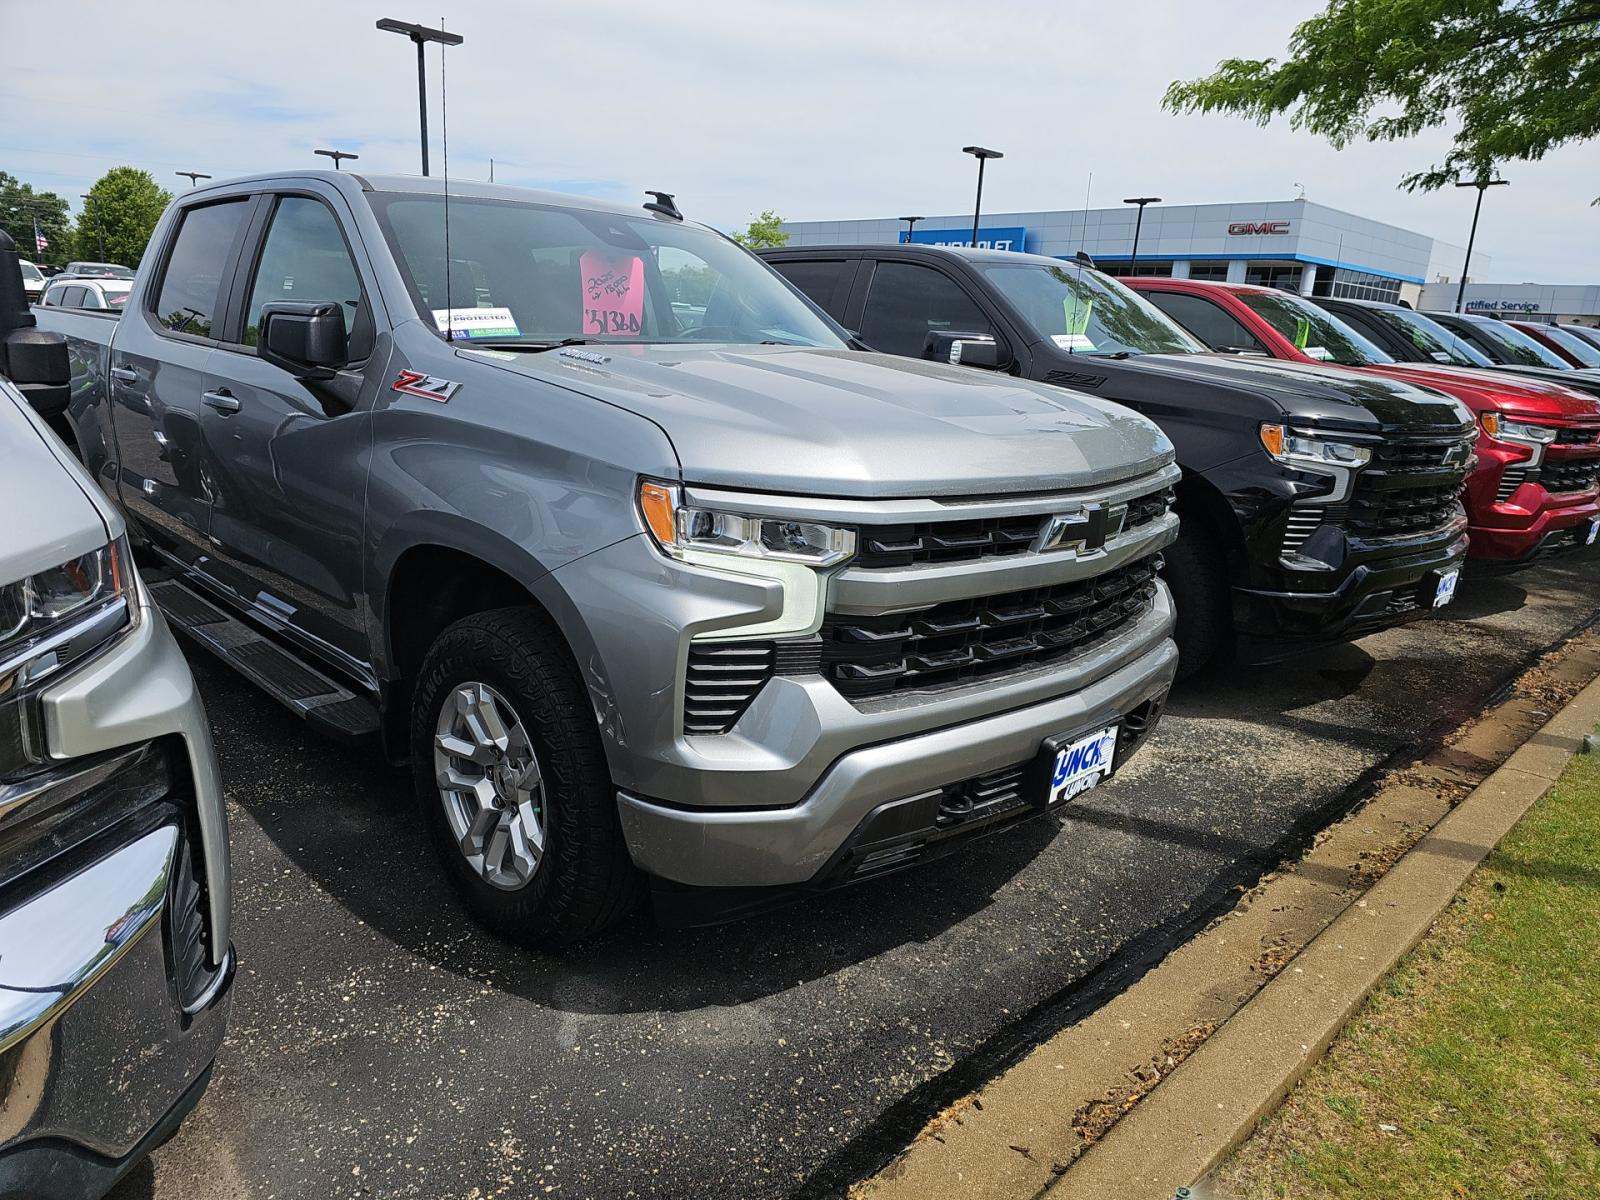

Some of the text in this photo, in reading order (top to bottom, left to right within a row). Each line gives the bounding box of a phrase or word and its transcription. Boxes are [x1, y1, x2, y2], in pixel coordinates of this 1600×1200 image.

[1228, 221, 1291, 235] GMC
[1465, 300, 1540, 311] rtified Service
[391, 368, 464, 404] Z71
